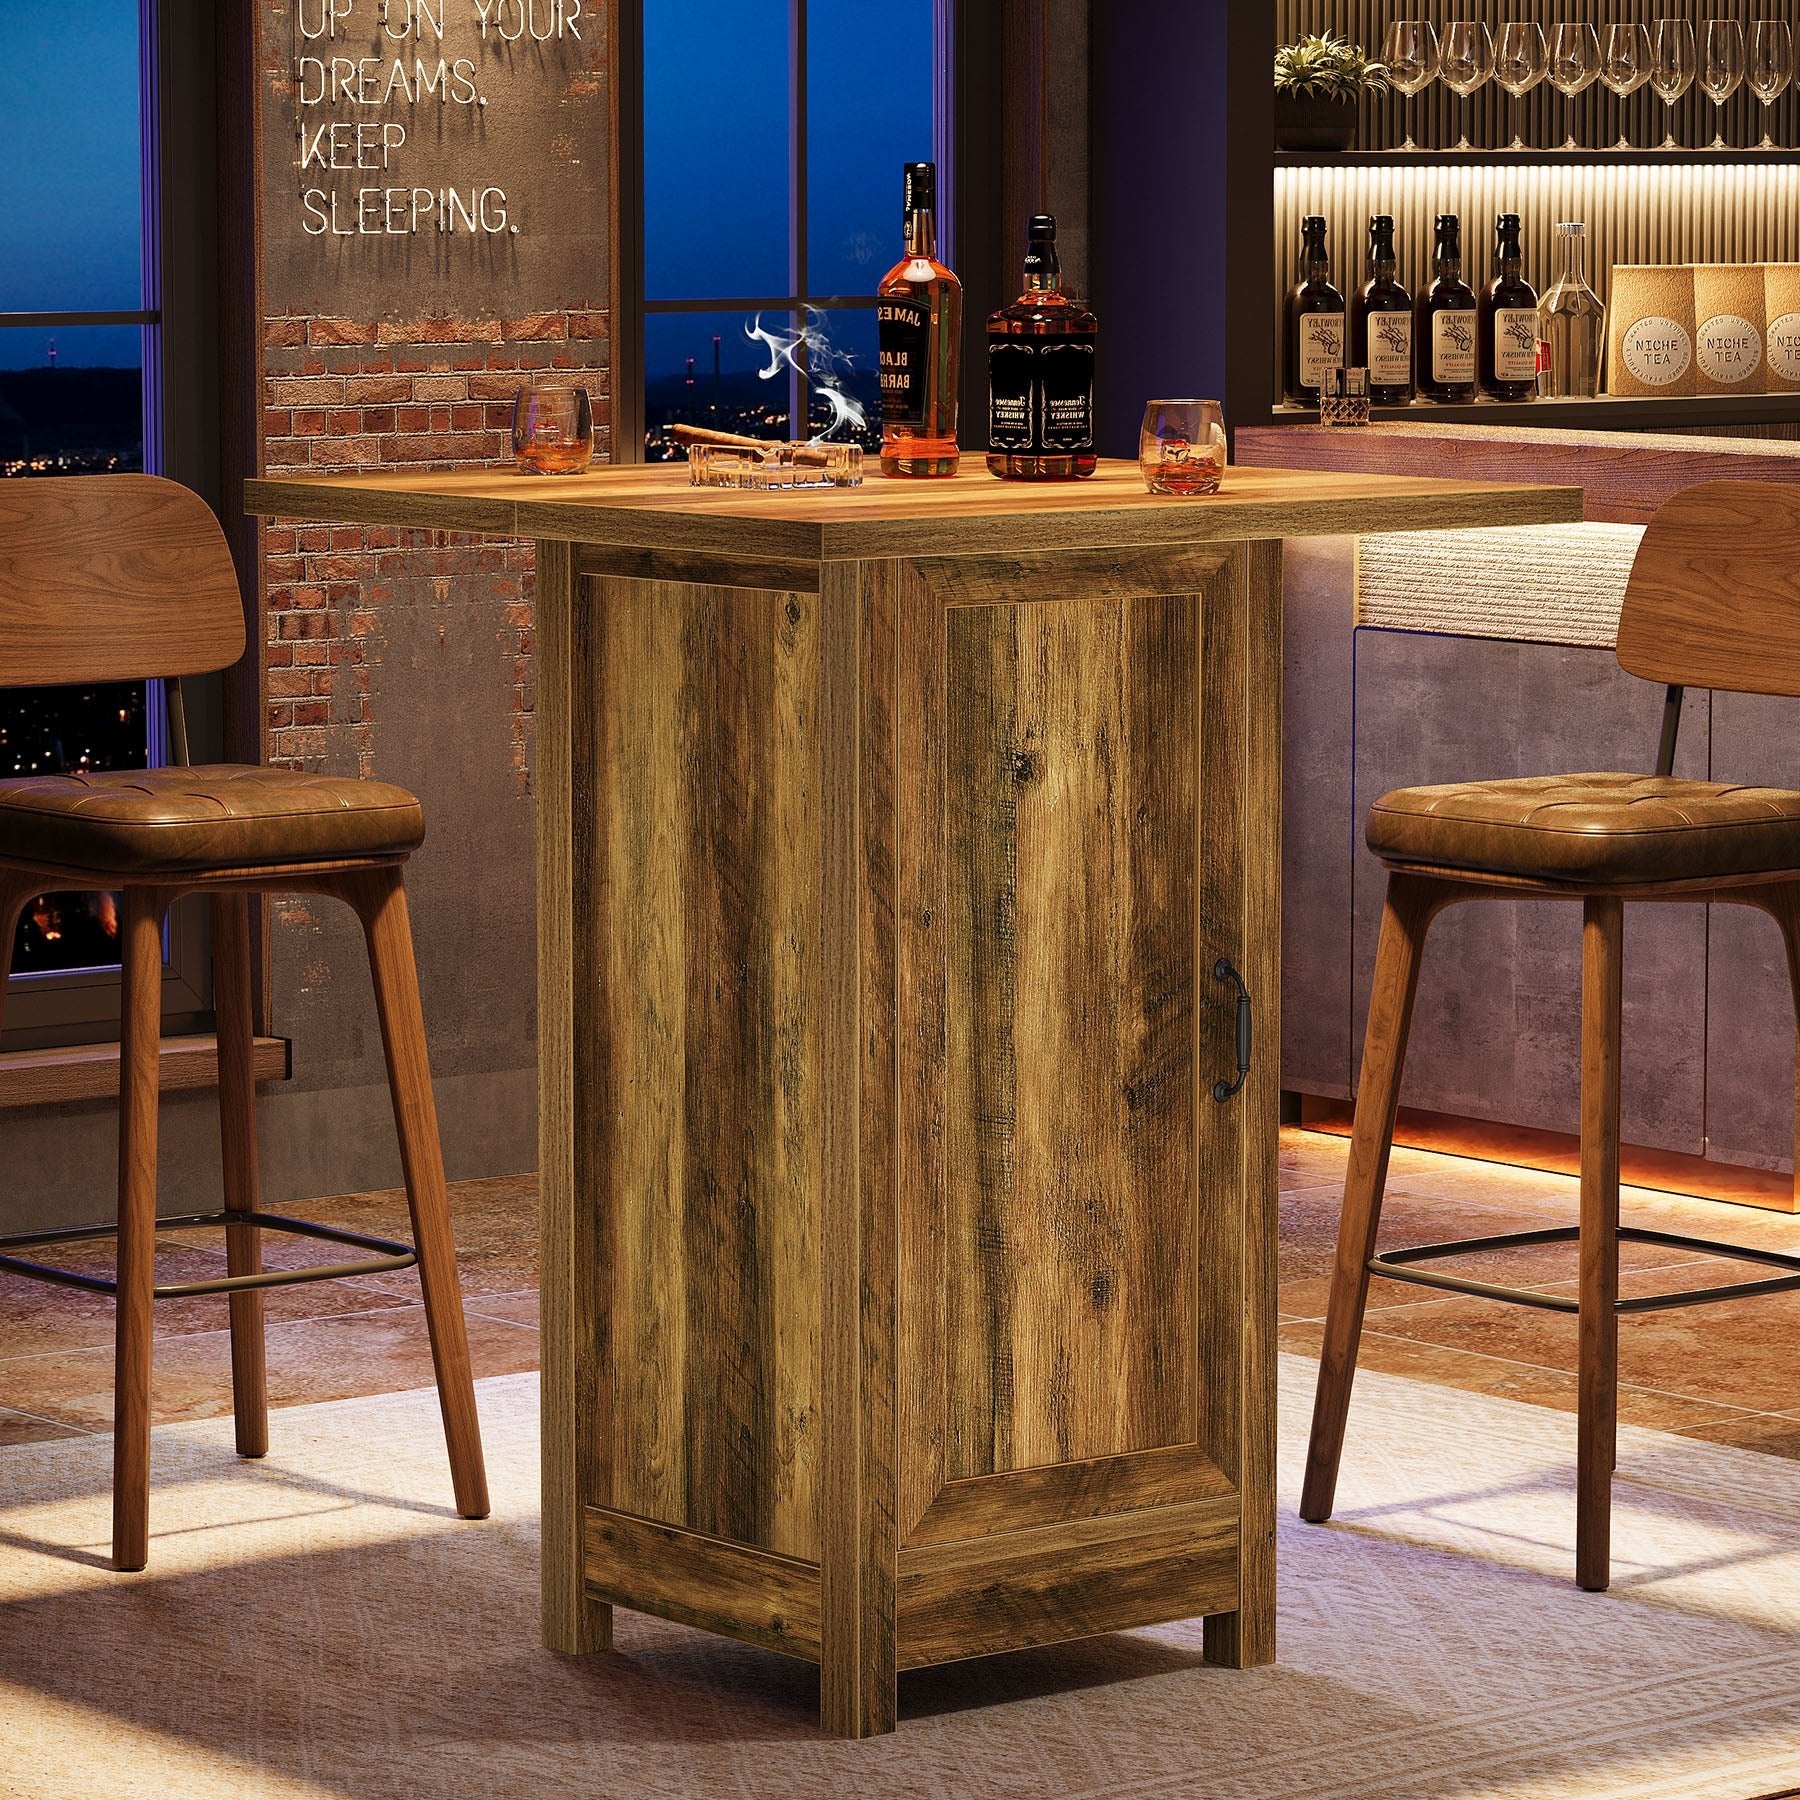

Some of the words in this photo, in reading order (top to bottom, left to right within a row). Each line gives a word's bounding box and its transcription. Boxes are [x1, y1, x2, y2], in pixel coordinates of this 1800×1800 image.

[299, 0, 353, 40] UP
[384, 0, 443, 40] ON
[474, 0, 582, 40] YOUR
[299, 58, 488, 105] DREAMS.
[301, 123, 406, 169] KEEP
[302, 187, 520, 235] SLEEPING.
[1627, 320, 1653, 342] CRAFTED
[1659, 319, 1688, 346] UNIQUELY
[1706, 338, 1749, 349] NICHE
[1730, 317, 1759, 345] UNIQUELY
[1635, 339, 1679, 351] NICHE
[1715, 351, 1742, 362] TEA
[1644, 353, 1671, 365] TEA
